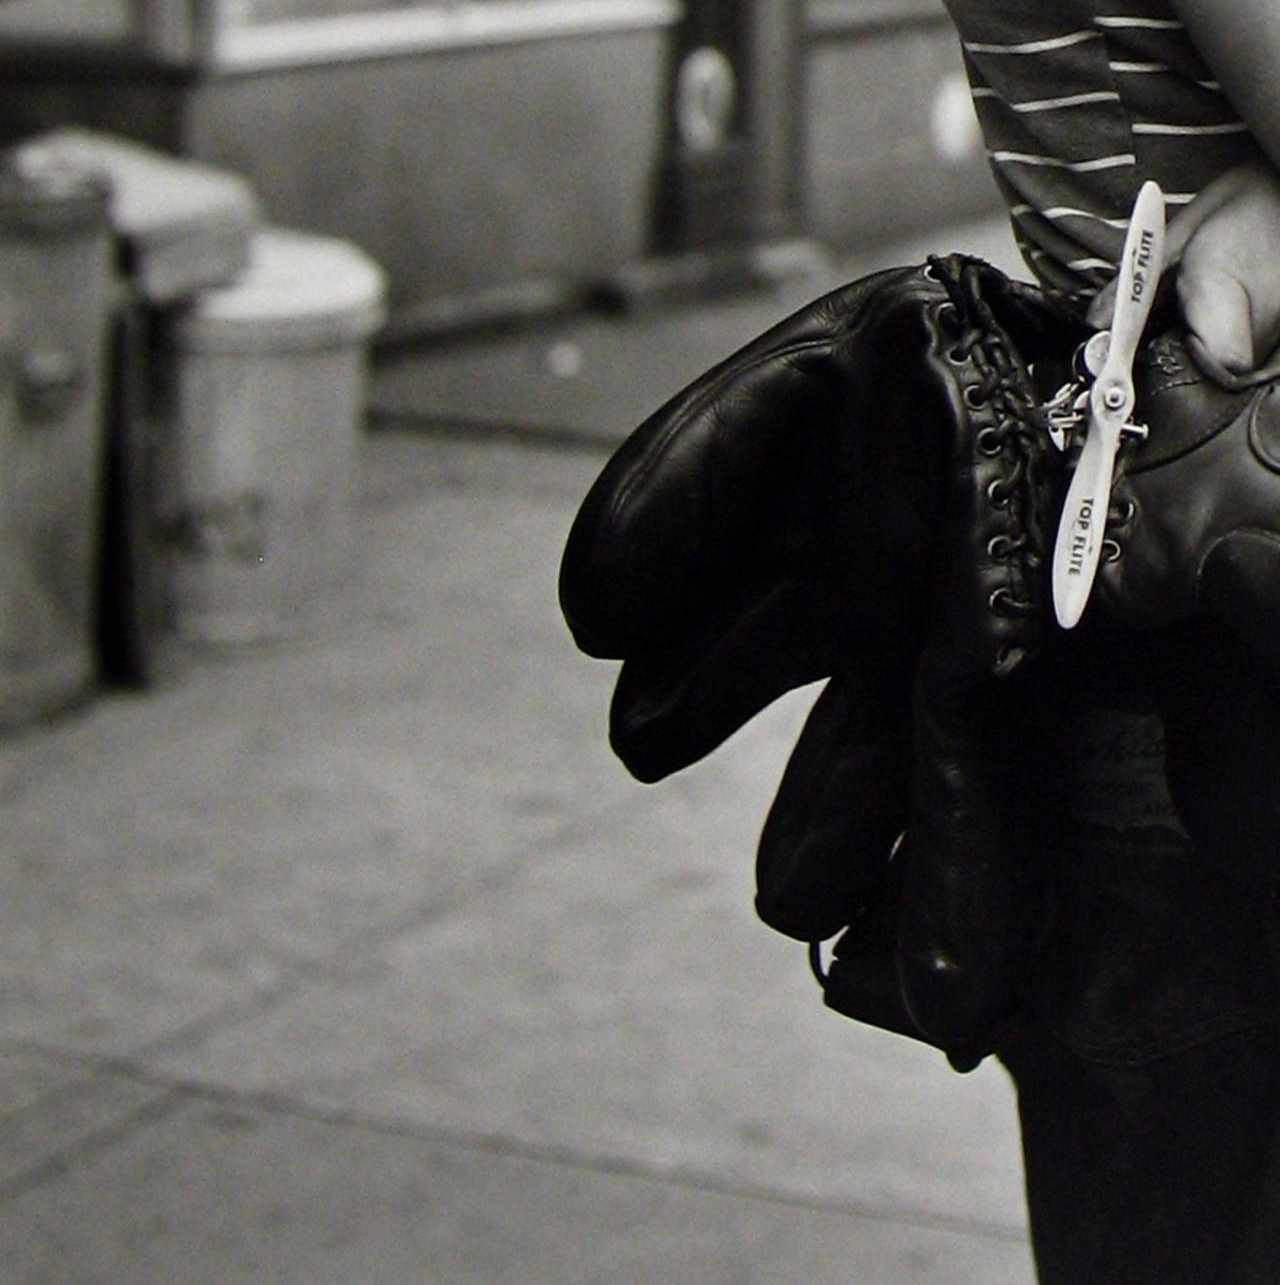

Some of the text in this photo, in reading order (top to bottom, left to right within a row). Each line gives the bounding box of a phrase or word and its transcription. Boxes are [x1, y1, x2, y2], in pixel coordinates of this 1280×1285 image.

[1131, 230, 1154, 302] TOP FLITE
[1068, 498, 1094, 575] TOP FLITE
